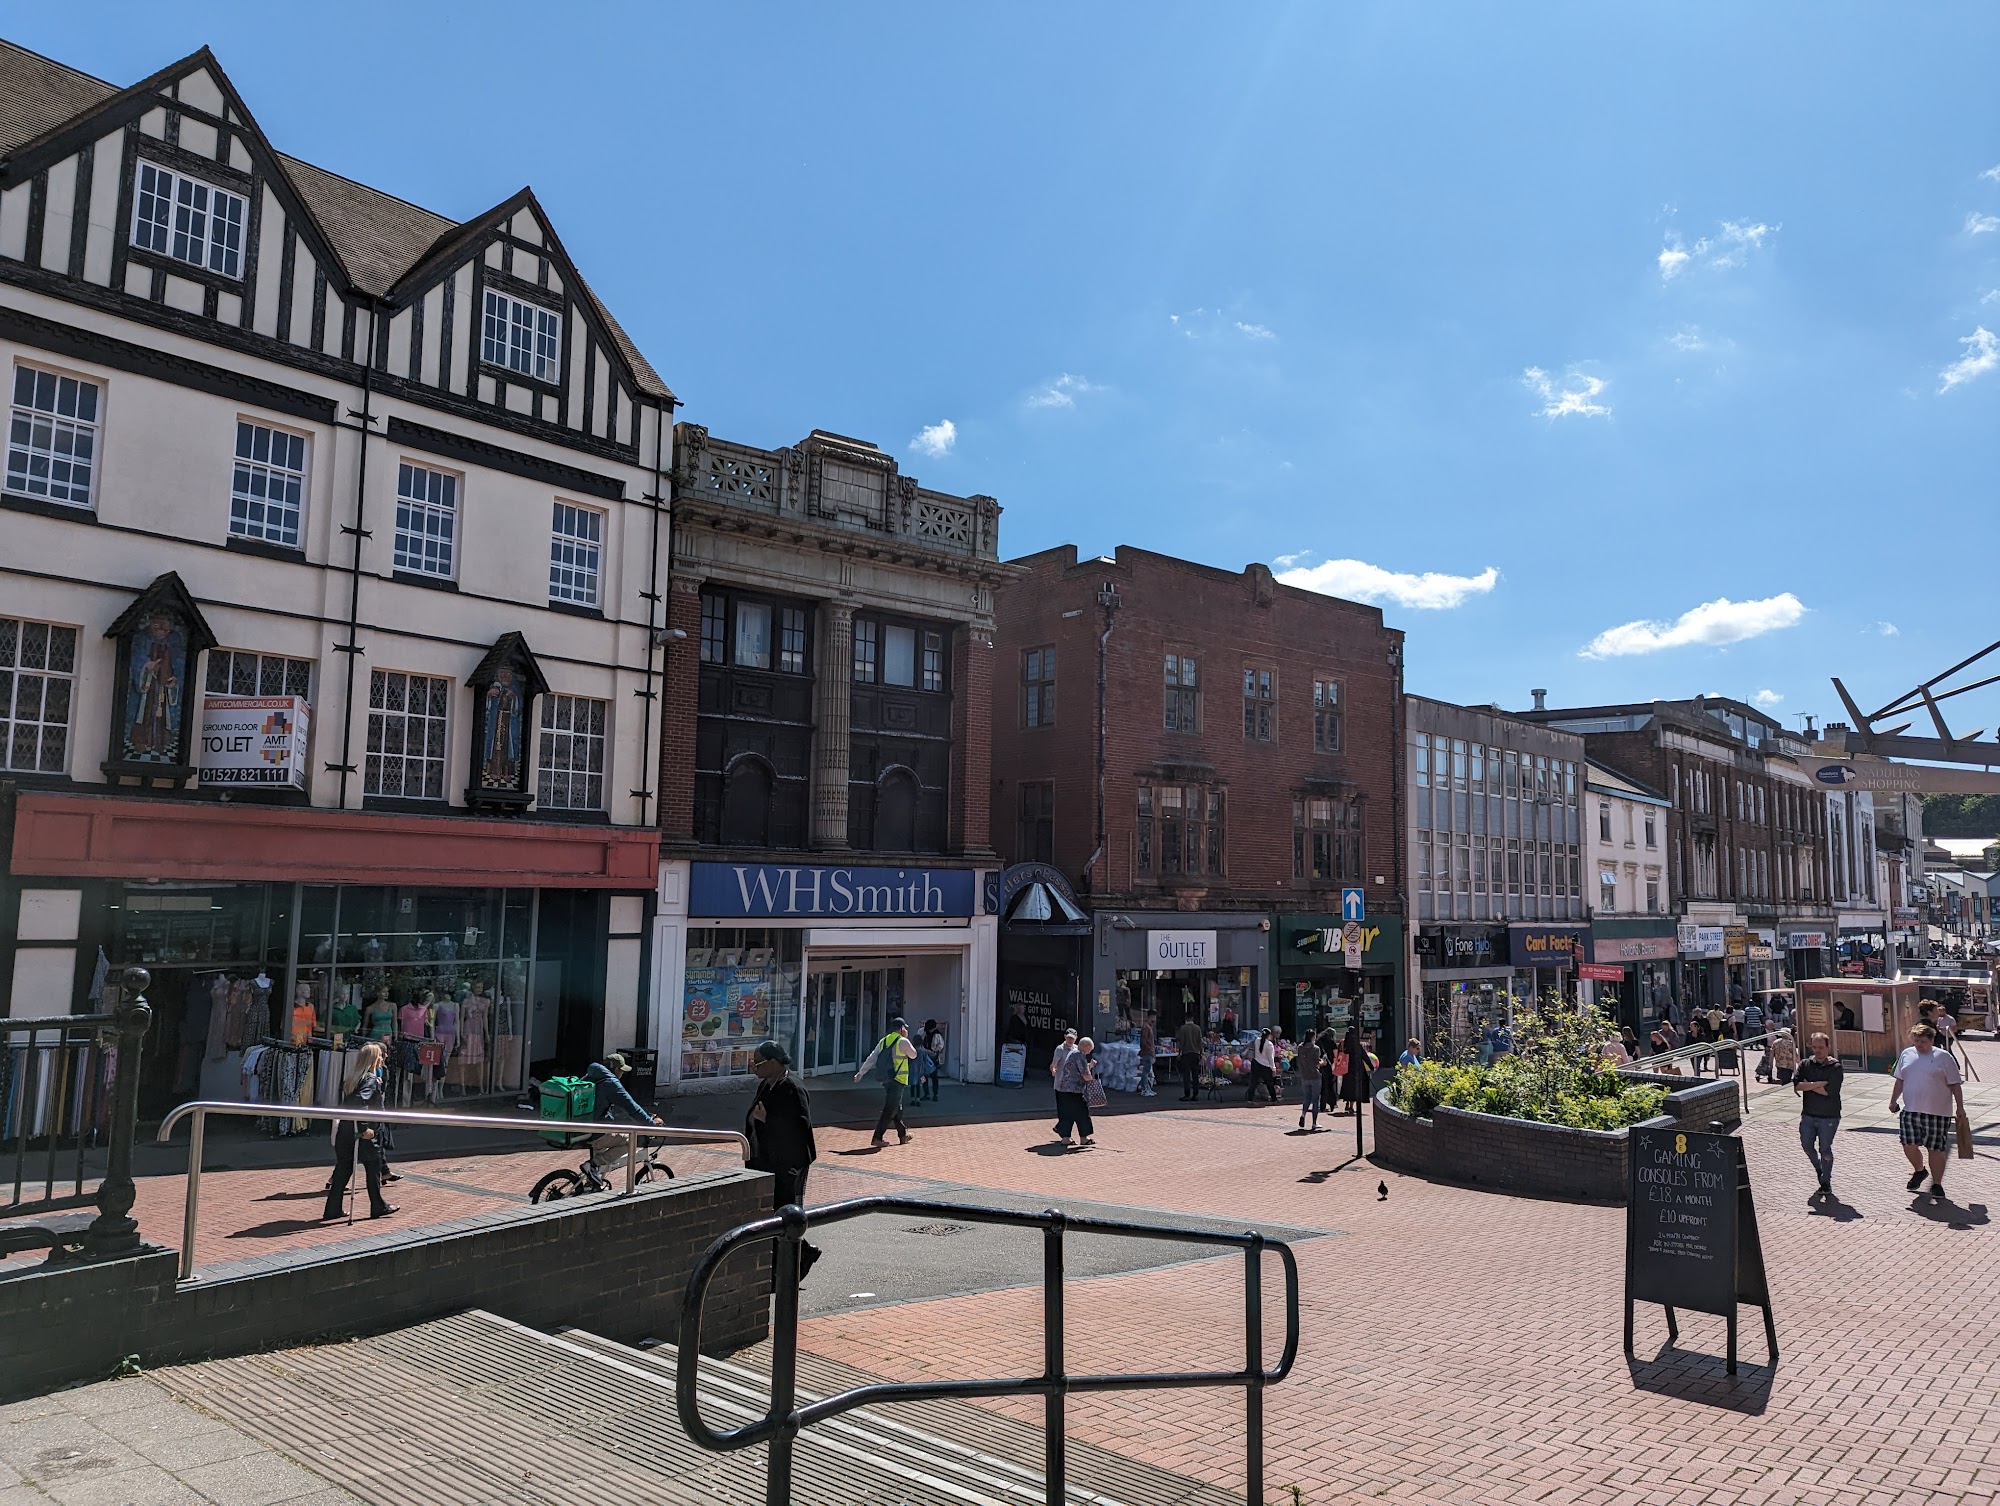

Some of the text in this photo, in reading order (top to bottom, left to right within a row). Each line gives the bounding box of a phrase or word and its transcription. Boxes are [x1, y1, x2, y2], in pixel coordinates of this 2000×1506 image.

[203, 723, 258, 731] GROUND FLOOR
[202, 736, 253, 752] TO LET
[264, 735, 287, 745] AMT
[202, 769, 238, 781] 01527
[240, 769, 261, 781] 821
[264, 769, 284, 781] 111
[1861, 767, 1920, 778] SADDLERS
[1861, 779, 1920, 790] SHOPPING
[732, 867, 944, 914] WHSmith
[986, 883, 999, 913] S
[1160, 933, 1171, 941] THE
[1296, 933, 1320, 948] SUBWAY
[1699, 931, 1722, 941] PARK STREET
[1474, 935, 1490, 951] Hub
[1525, 934, 1546, 951] Card
[1703, 943, 1719, 952] ARCADE
[1159, 942, 1206, 958] OUTLET
[1186, 958, 1206, 966] STORE
[690, 998, 707, 1006] Only
[1009, 989, 1052, 1006] WALSALL
[691, 1006, 706, 1016] £2
[738, 1000, 746, 1011] 3
[749, 999, 758, 1011] 2
[1027, 1005, 1039, 1014] GOT
[426, 1050, 435, 1062] £1
[1654, 1148, 1701, 1169] GAMING
[1638, 1166, 1724, 1191] CONSOLES FROM
[1648, 1185, 1713, 1207] £18 A MONTH
[1659, 1208, 1708, 1226] £10 UPFRONT
